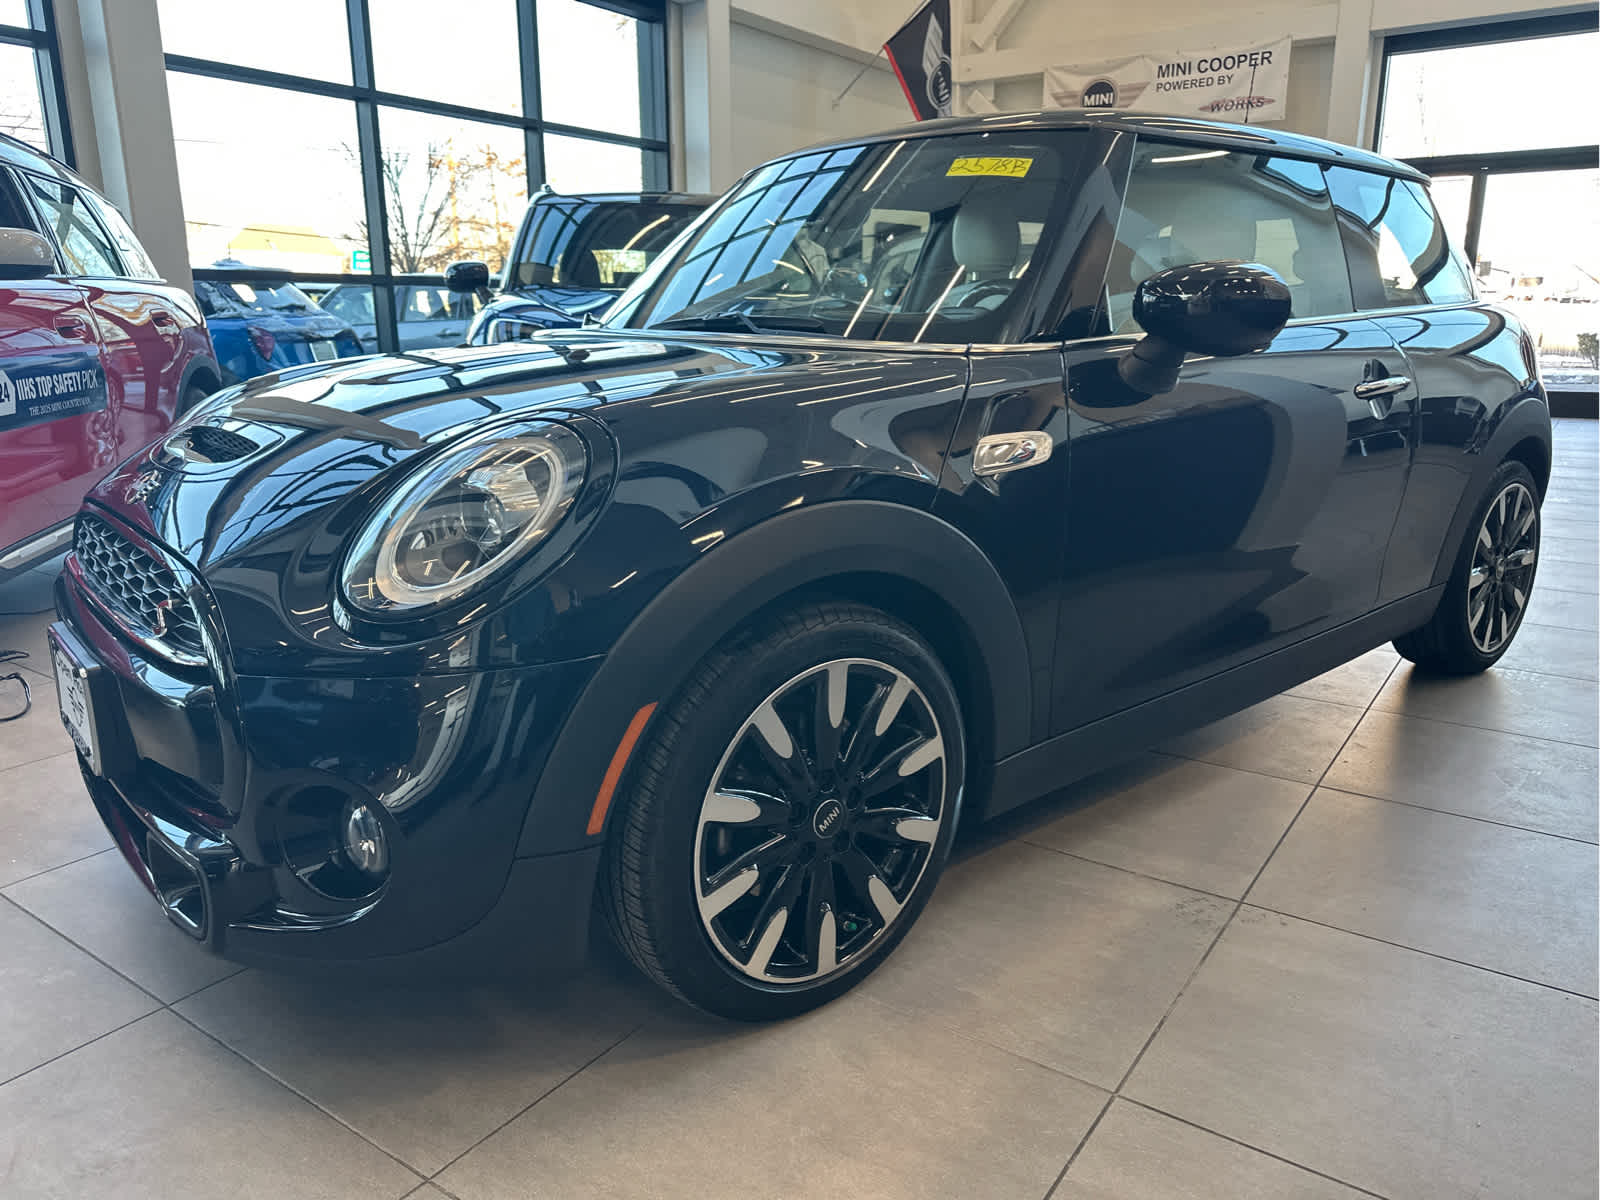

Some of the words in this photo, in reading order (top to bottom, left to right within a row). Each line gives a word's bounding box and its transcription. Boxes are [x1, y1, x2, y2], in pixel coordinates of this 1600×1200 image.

[1157, 61, 1192, 79] MINI
[1197, 51, 1273, 74] COOPER
[1156, 77, 1214, 93] POWERED
[1217, 74, 1235, 87] BY
[1083, 93, 1114, 108] MINI
[1210, 97, 1265, 113] WORKS
[16, 377, 37, 401] IIHS
[35, 375, 52, 398] TOP
[53, 372, 82, 394] SAFETY
[81, 369, 98, 391] PICK
[29, 406, 40, 416] THE
[819, 807, 840, 832] MINI
